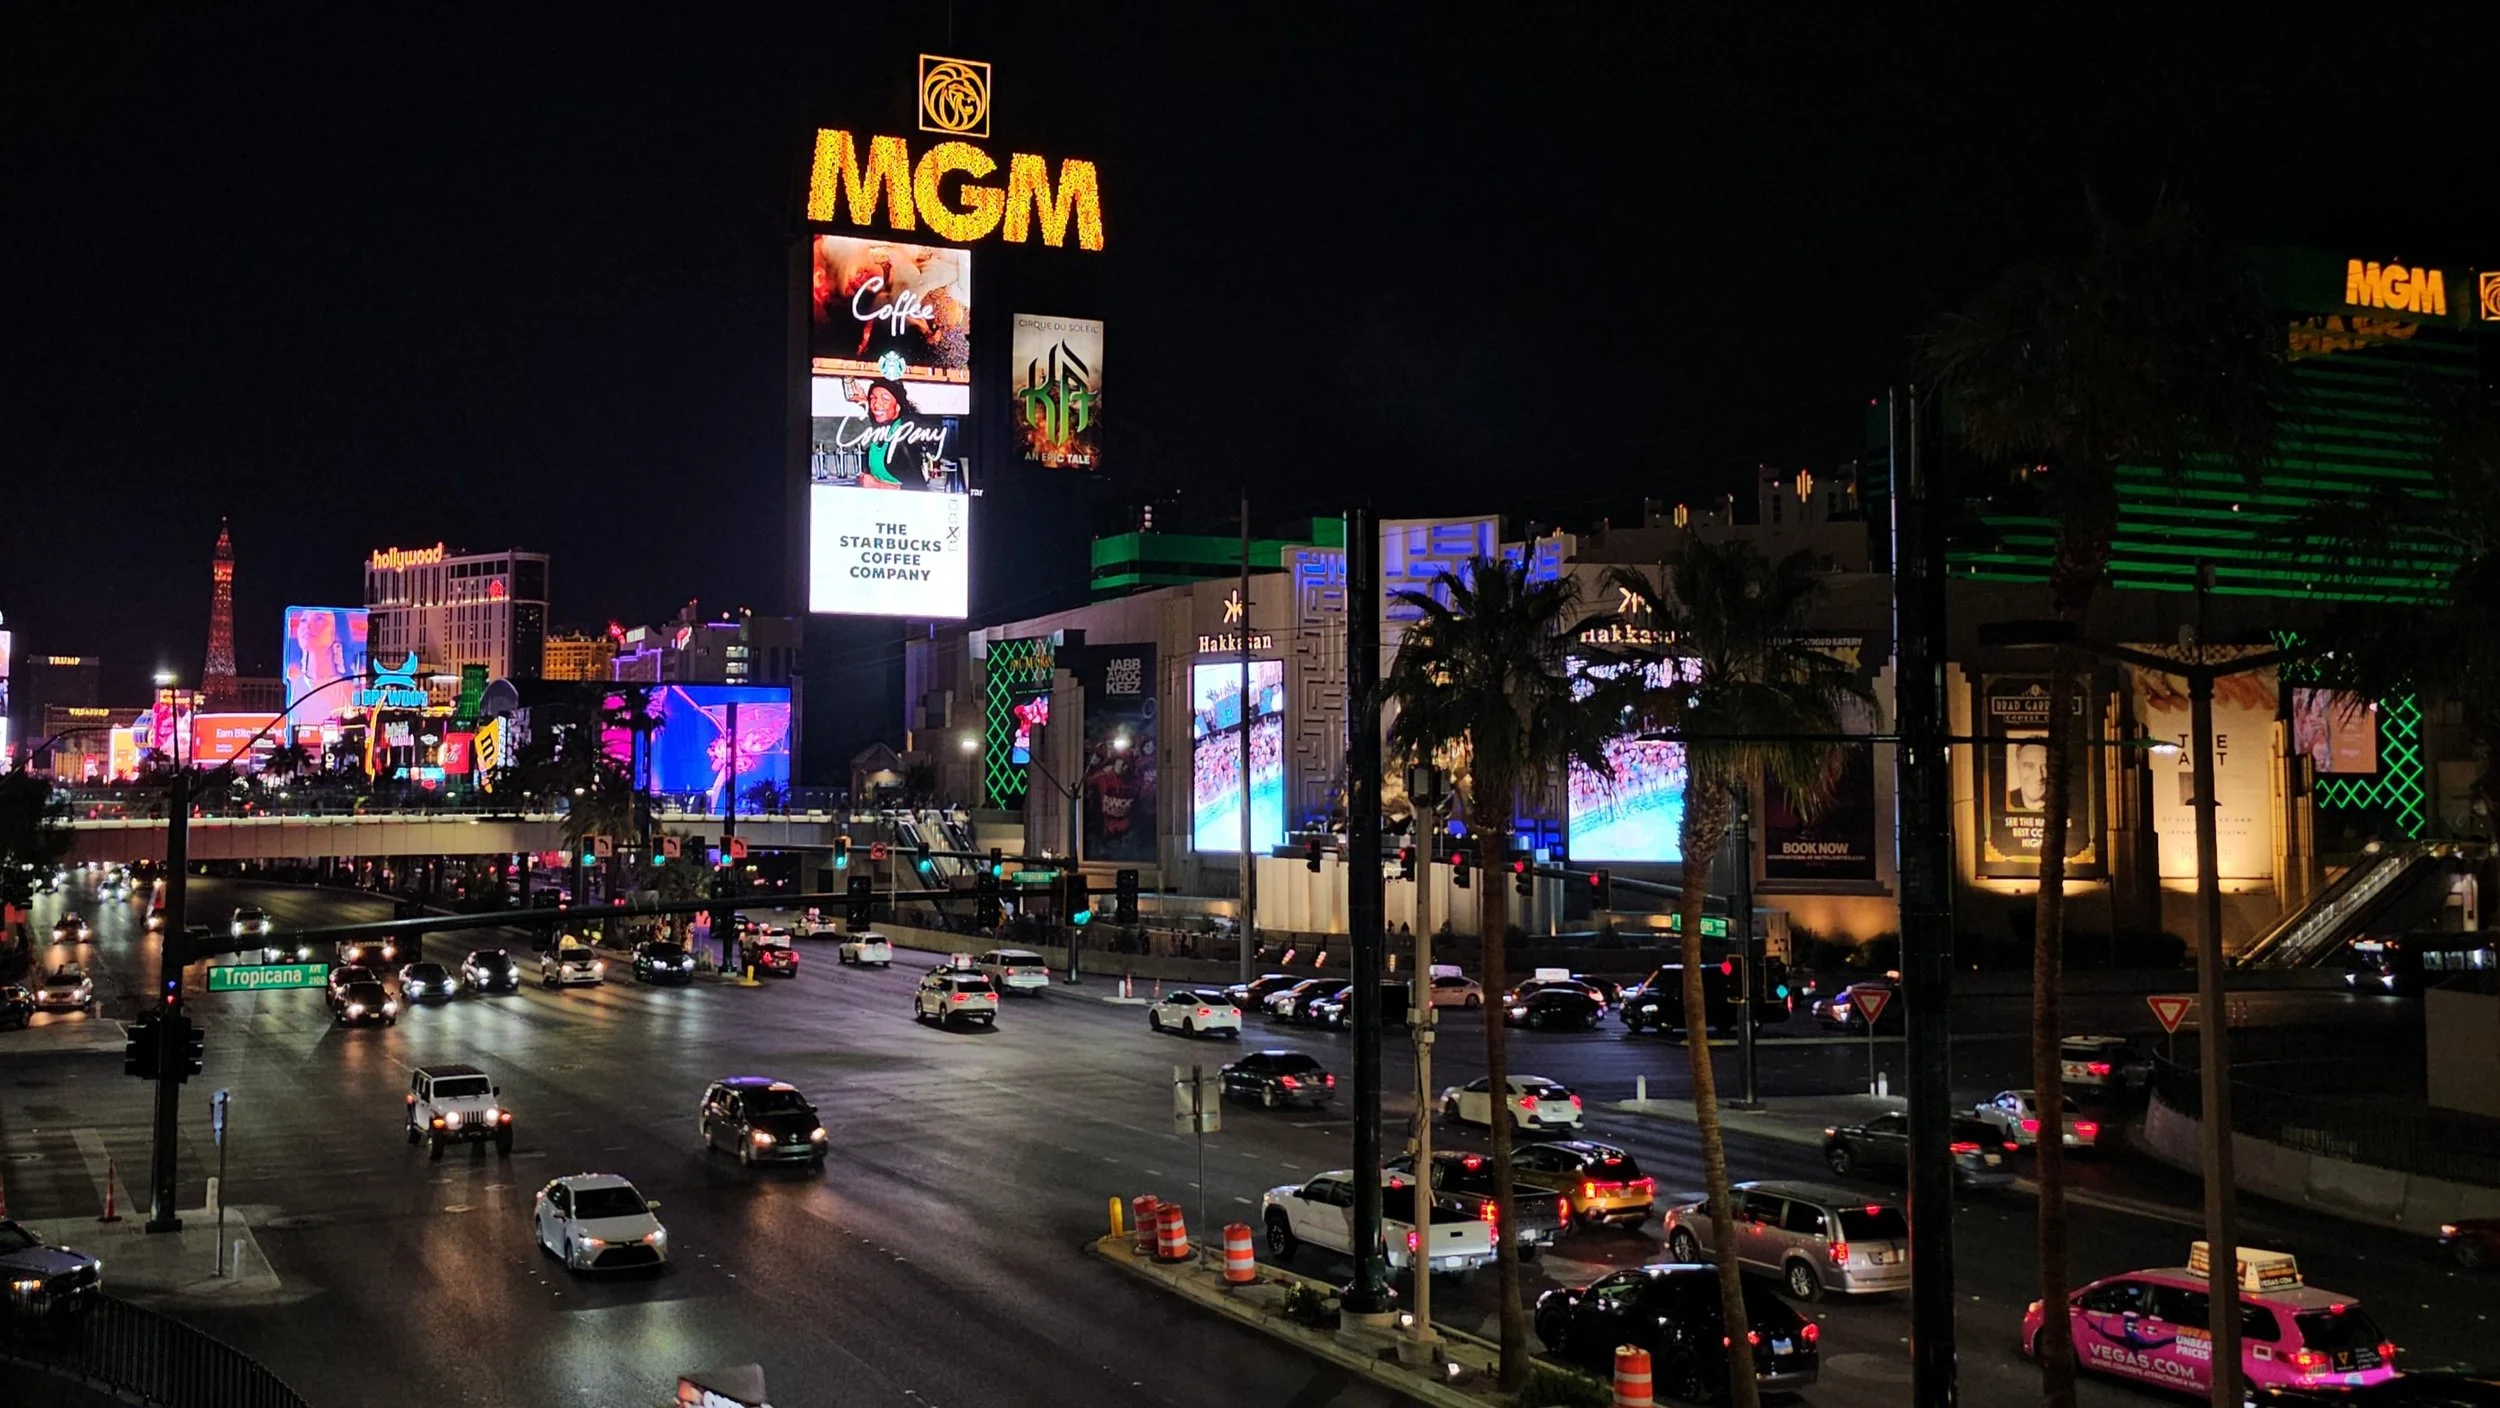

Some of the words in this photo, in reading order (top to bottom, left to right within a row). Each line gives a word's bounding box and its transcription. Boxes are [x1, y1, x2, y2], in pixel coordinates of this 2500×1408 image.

[807, 128, 1105, 252] MGM
[2345, 259, 2446, 316] MGM
[852, 276, 935, 337] Coffee
[1019, 319, 1051, 332] CIRQUE
[1054, 322, 1067, 332] DU
[1069, 324, 1098, 335] SOLEIL
[836, 402, 948, 464] Company
[1024, 451, 1039, 462] AN
[1042, 453, 1064, 464] EPIC
[1067, 453, 1091, 465] TALE
[876, 523, 907, 535] THE
[840, 535, 942, 552] STARBUCKS
[372, 541, 444, 572] hollywood
[861, 552, 921, 566] COFFEE
[850, 566, 931, 581] COMPANY
[49, 656, 81, 666] TRUMP
[1107, 658, 1141, 671] JABB
[1106, 682, 1141, 694] KEEZ
[1996, 701, 2021, 711] BRAD
[2019, 817, 2034, 827] THE
[2013, 828, 2030, 838] BEST
[1782, 842, 1817, 854] BOOK
[1818, 842, 1849, 854] NOW
[224, 967, 302, 989] Tropicana
[308, 964, 323, 974] AVE
[2176, 1345, 2210, 1361] PRICES
[2088, 1342, 2196, 1380] VEGAS.COM
